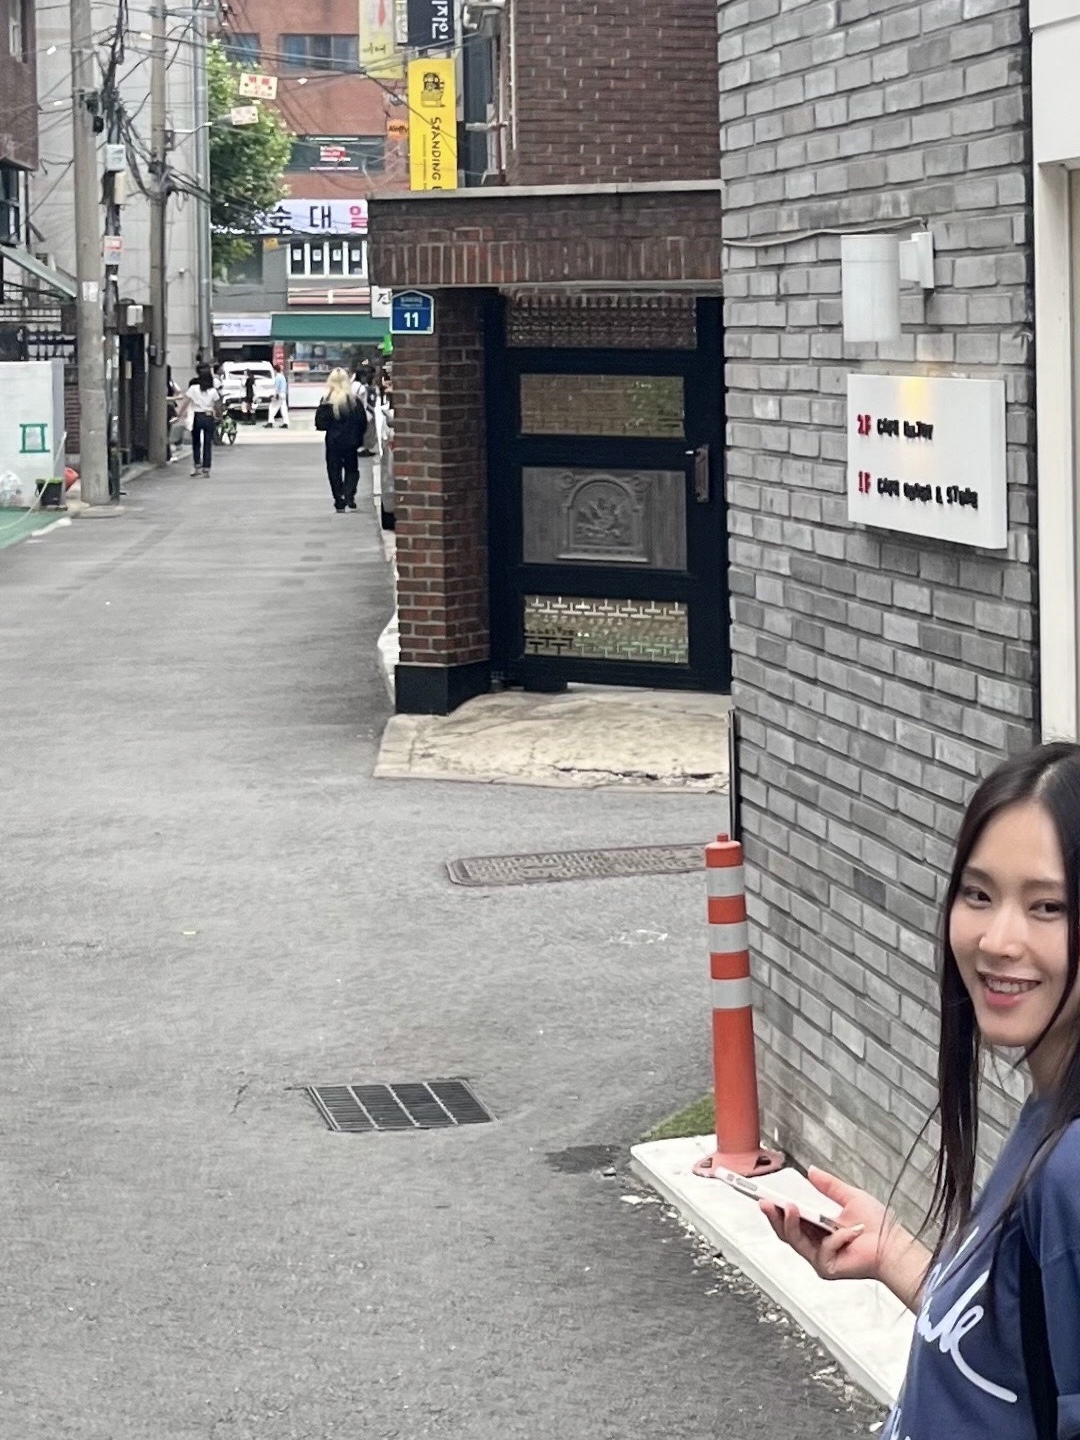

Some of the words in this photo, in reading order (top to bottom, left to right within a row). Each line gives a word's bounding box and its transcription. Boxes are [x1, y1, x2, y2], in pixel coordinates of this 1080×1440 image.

[430, 116, 442, 181] STANDING
[403, 311, 419, 328] 11
[857, 414, 871, 436] 2F
[858, 470, 871, 494] 1F
